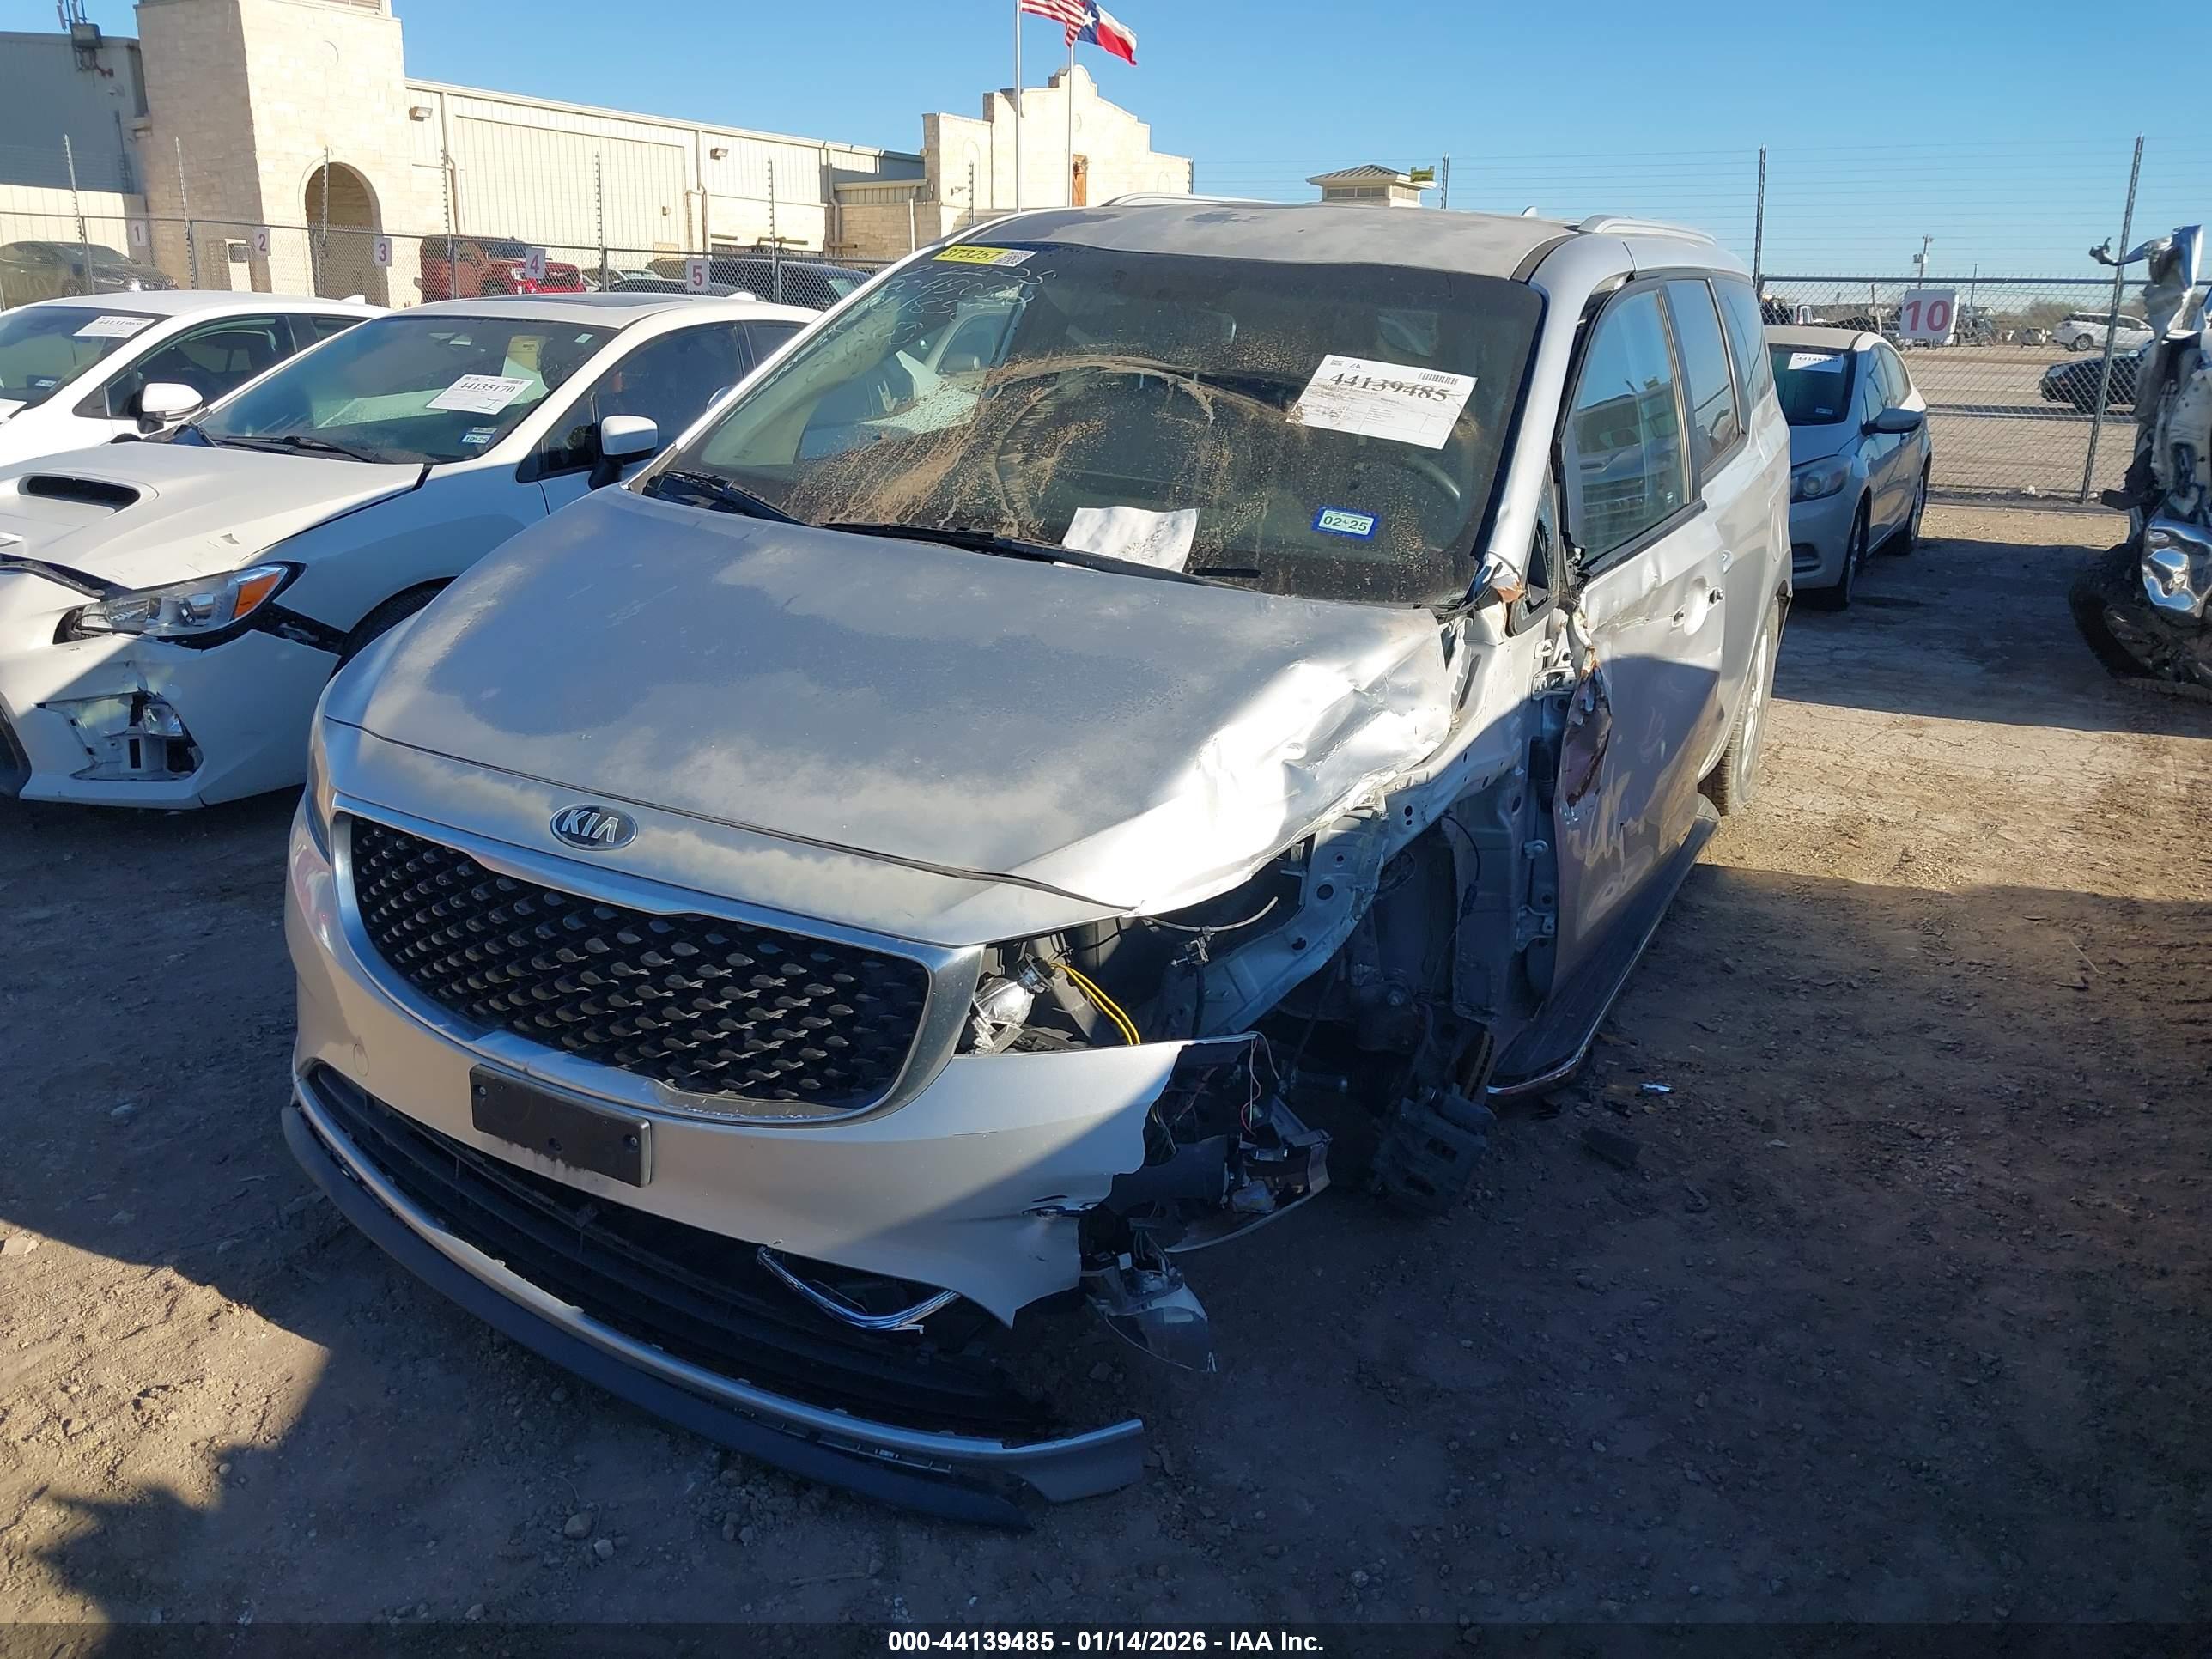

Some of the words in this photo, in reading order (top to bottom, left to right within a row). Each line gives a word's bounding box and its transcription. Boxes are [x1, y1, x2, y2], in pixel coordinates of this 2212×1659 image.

[134, 225, 140, 242] 1
[258, 233, 267, 252] 2
[379, 243, 387, 262] 3
[941, 248, 1004, 260] 373257
[530, 254, 540, 274] 4
[692, 264, 703, 287] 5
[1905, 300, 1951, 331] 10
[459, 382, 516, 393] 44135170
[1329, 372, 1450, 402] 44139485
[561, 809, 619, 843] KIA
